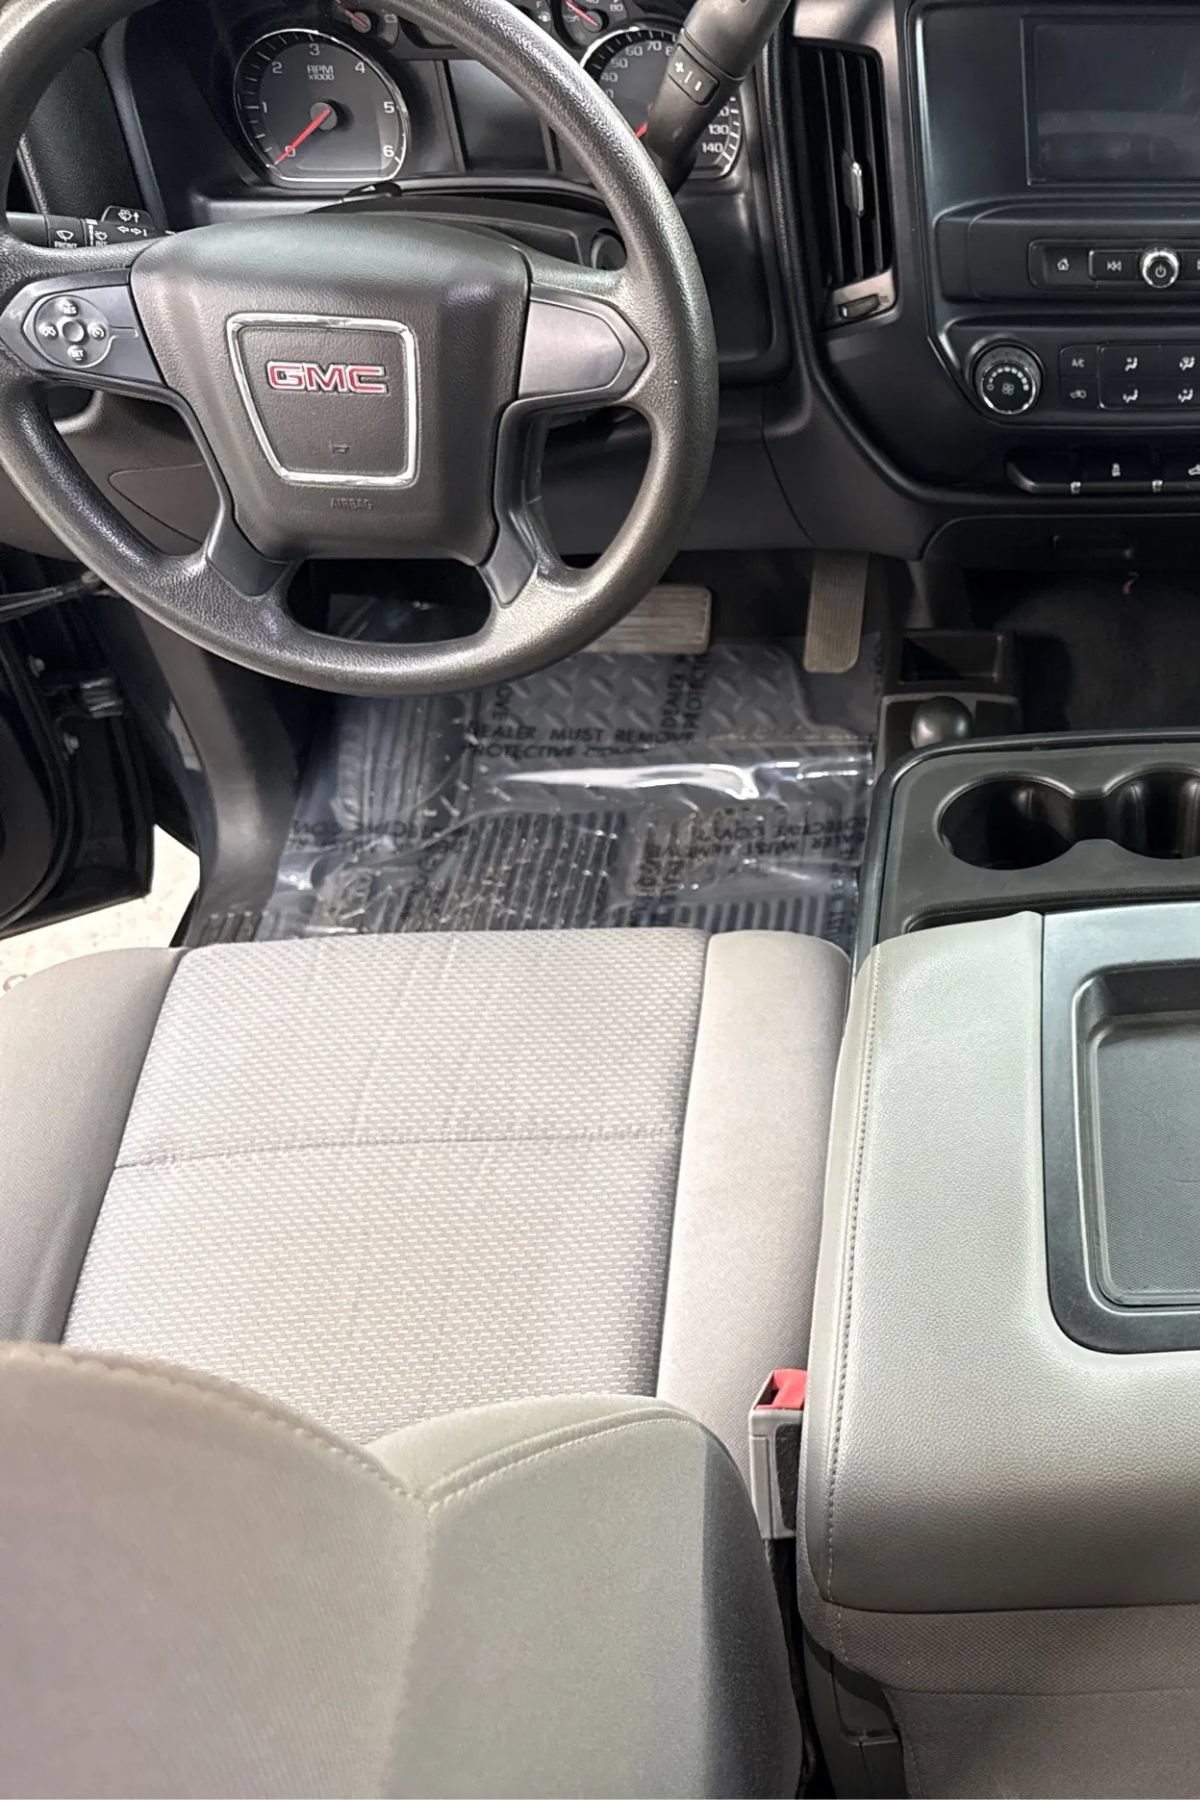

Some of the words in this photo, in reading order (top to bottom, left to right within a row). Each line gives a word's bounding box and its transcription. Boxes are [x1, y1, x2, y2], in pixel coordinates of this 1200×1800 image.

[309, 43, 320, 56] 3
[625, 46, 643, 56] 60
[647, 41, 662, 51] 70
[272, 62, 283, 74] 2
[354, 62, 366, 73] 4
[610, 58, 628, 68] 50
[307, 65, 334, 74] RPM
[262, 101, 268, 113] 1
[383, 102, 395, 114] 5
[708, 125, 729, 135] 130
[383, 145, 395, 157] 6
[702, 143, 723, 153] 140
[267, 361, 388, 393] GMC
